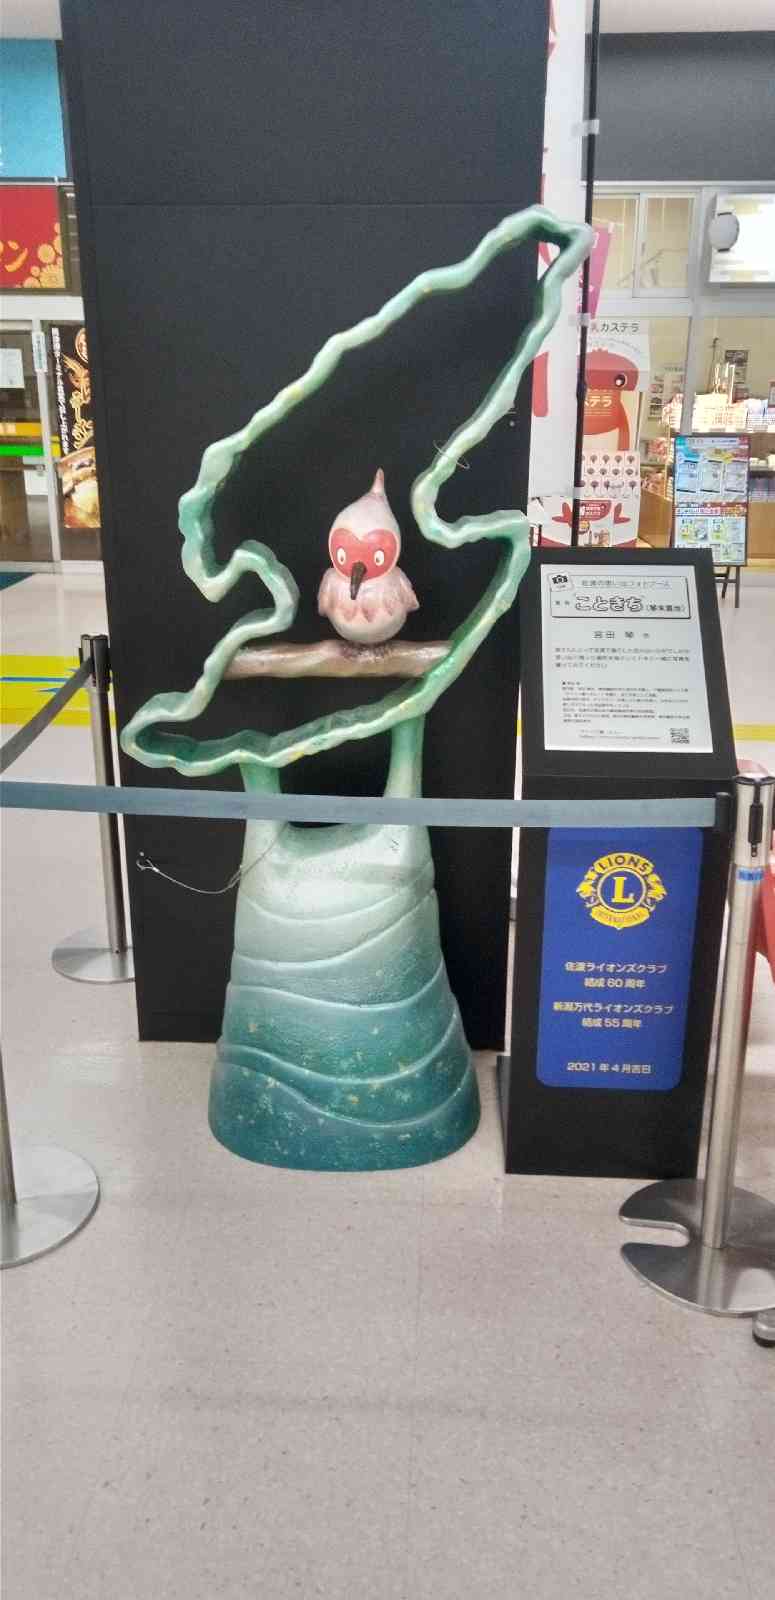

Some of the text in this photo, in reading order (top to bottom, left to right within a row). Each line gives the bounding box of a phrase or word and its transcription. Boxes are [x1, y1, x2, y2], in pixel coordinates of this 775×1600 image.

[574, 594, 643, 612] こときち
[597, 854, 650, 872] LIONS
[611, 876, 635, 904] L
[565, 961, 668, 974] 佐渡ライオンズクラブ
